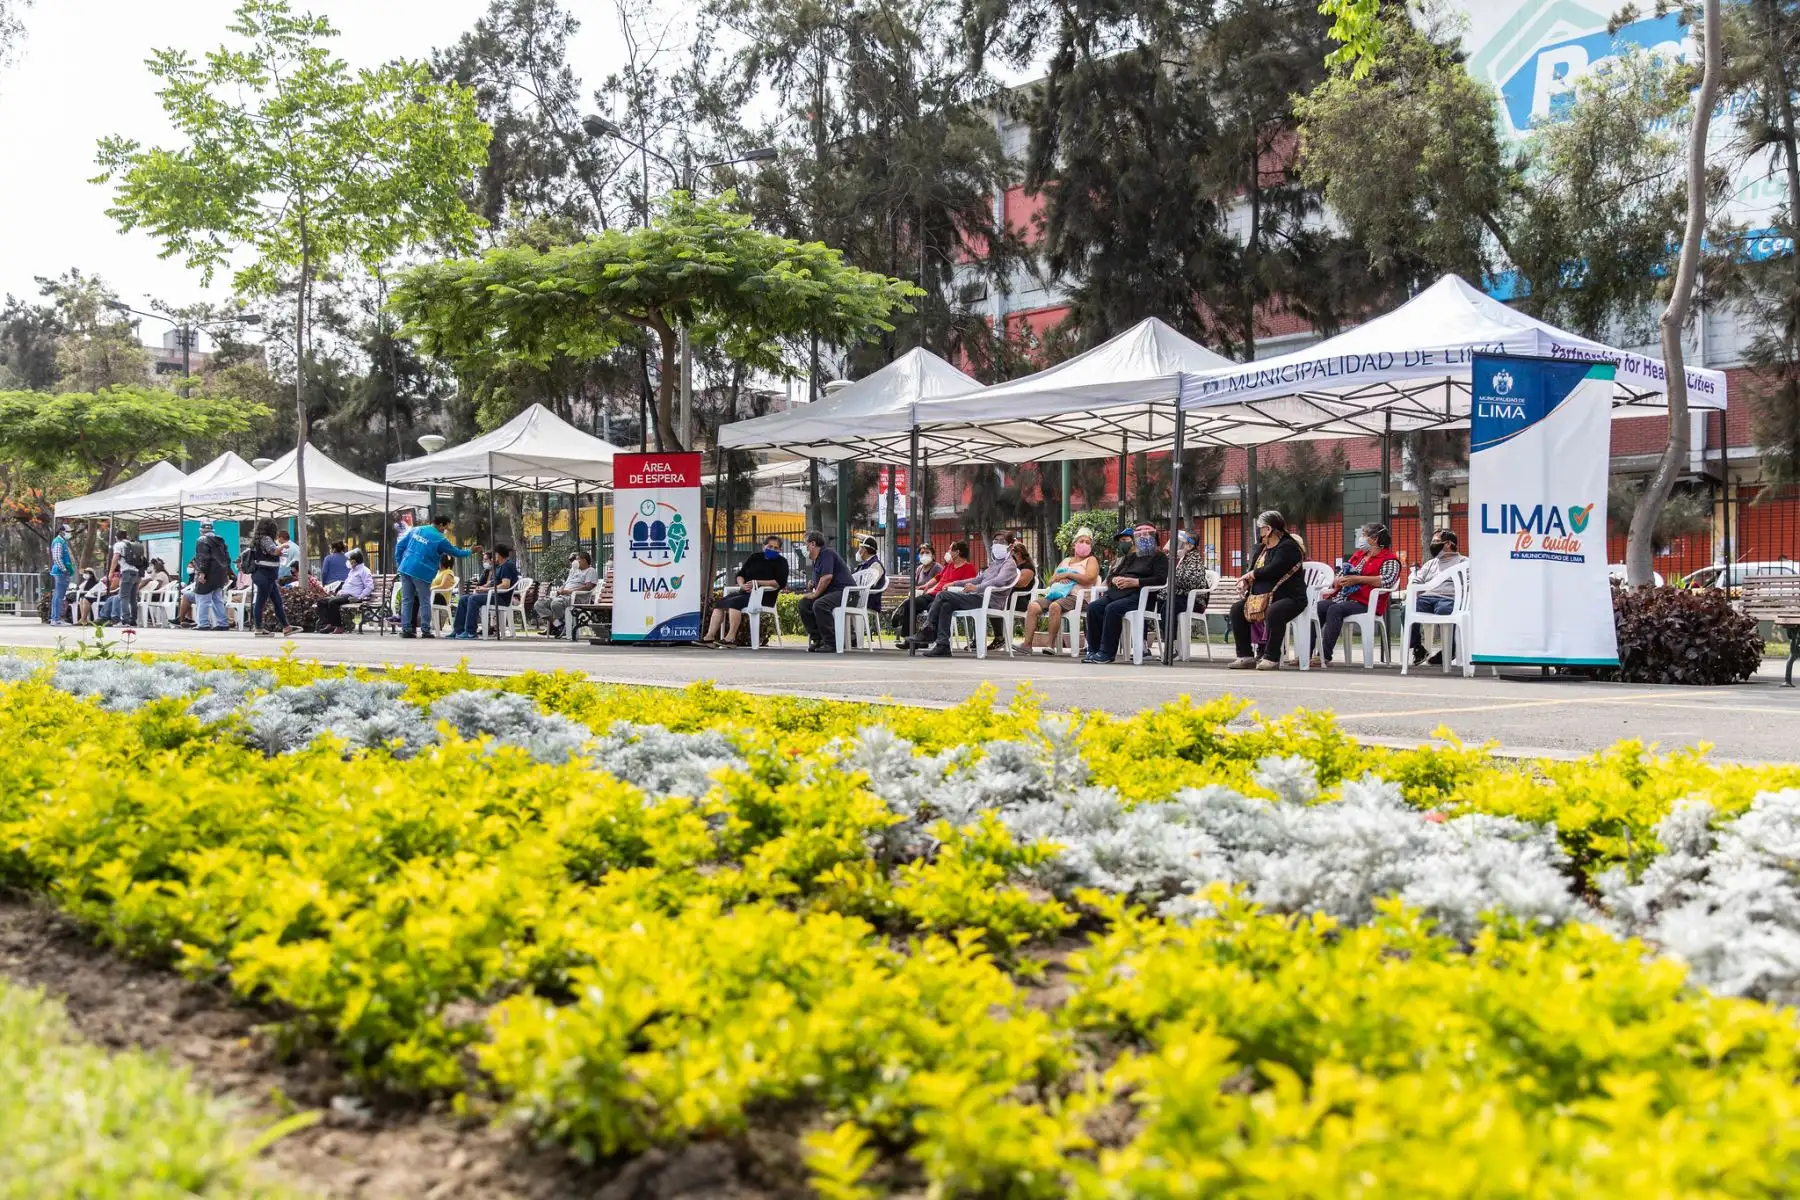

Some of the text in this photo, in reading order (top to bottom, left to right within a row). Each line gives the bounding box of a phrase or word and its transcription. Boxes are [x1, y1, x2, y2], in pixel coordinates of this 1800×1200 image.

[1229, 351, 1394, 392] MUNICIPALIDAD
[1405, 350, 1434, 367] DE
[1625, 353, 1640, 374] for
[1686, 373, 1715, 395] Cities
[1478, 404, 1526, 420] LIMA
[642, 461, 672, 473] ÁREA
[629, 473, 686, 484] DE ESPERA
[1481, 503, 1567, 536] LIMA
[1515, 529, 1582, 555] Te cuida
[1521, 553, 1562, 561] MUNICIPALIDAD
[630, 577, 669, 593] LIMA
[654, 590, 677, 600] cuida
[674, 629, 697, 637] LIMA
